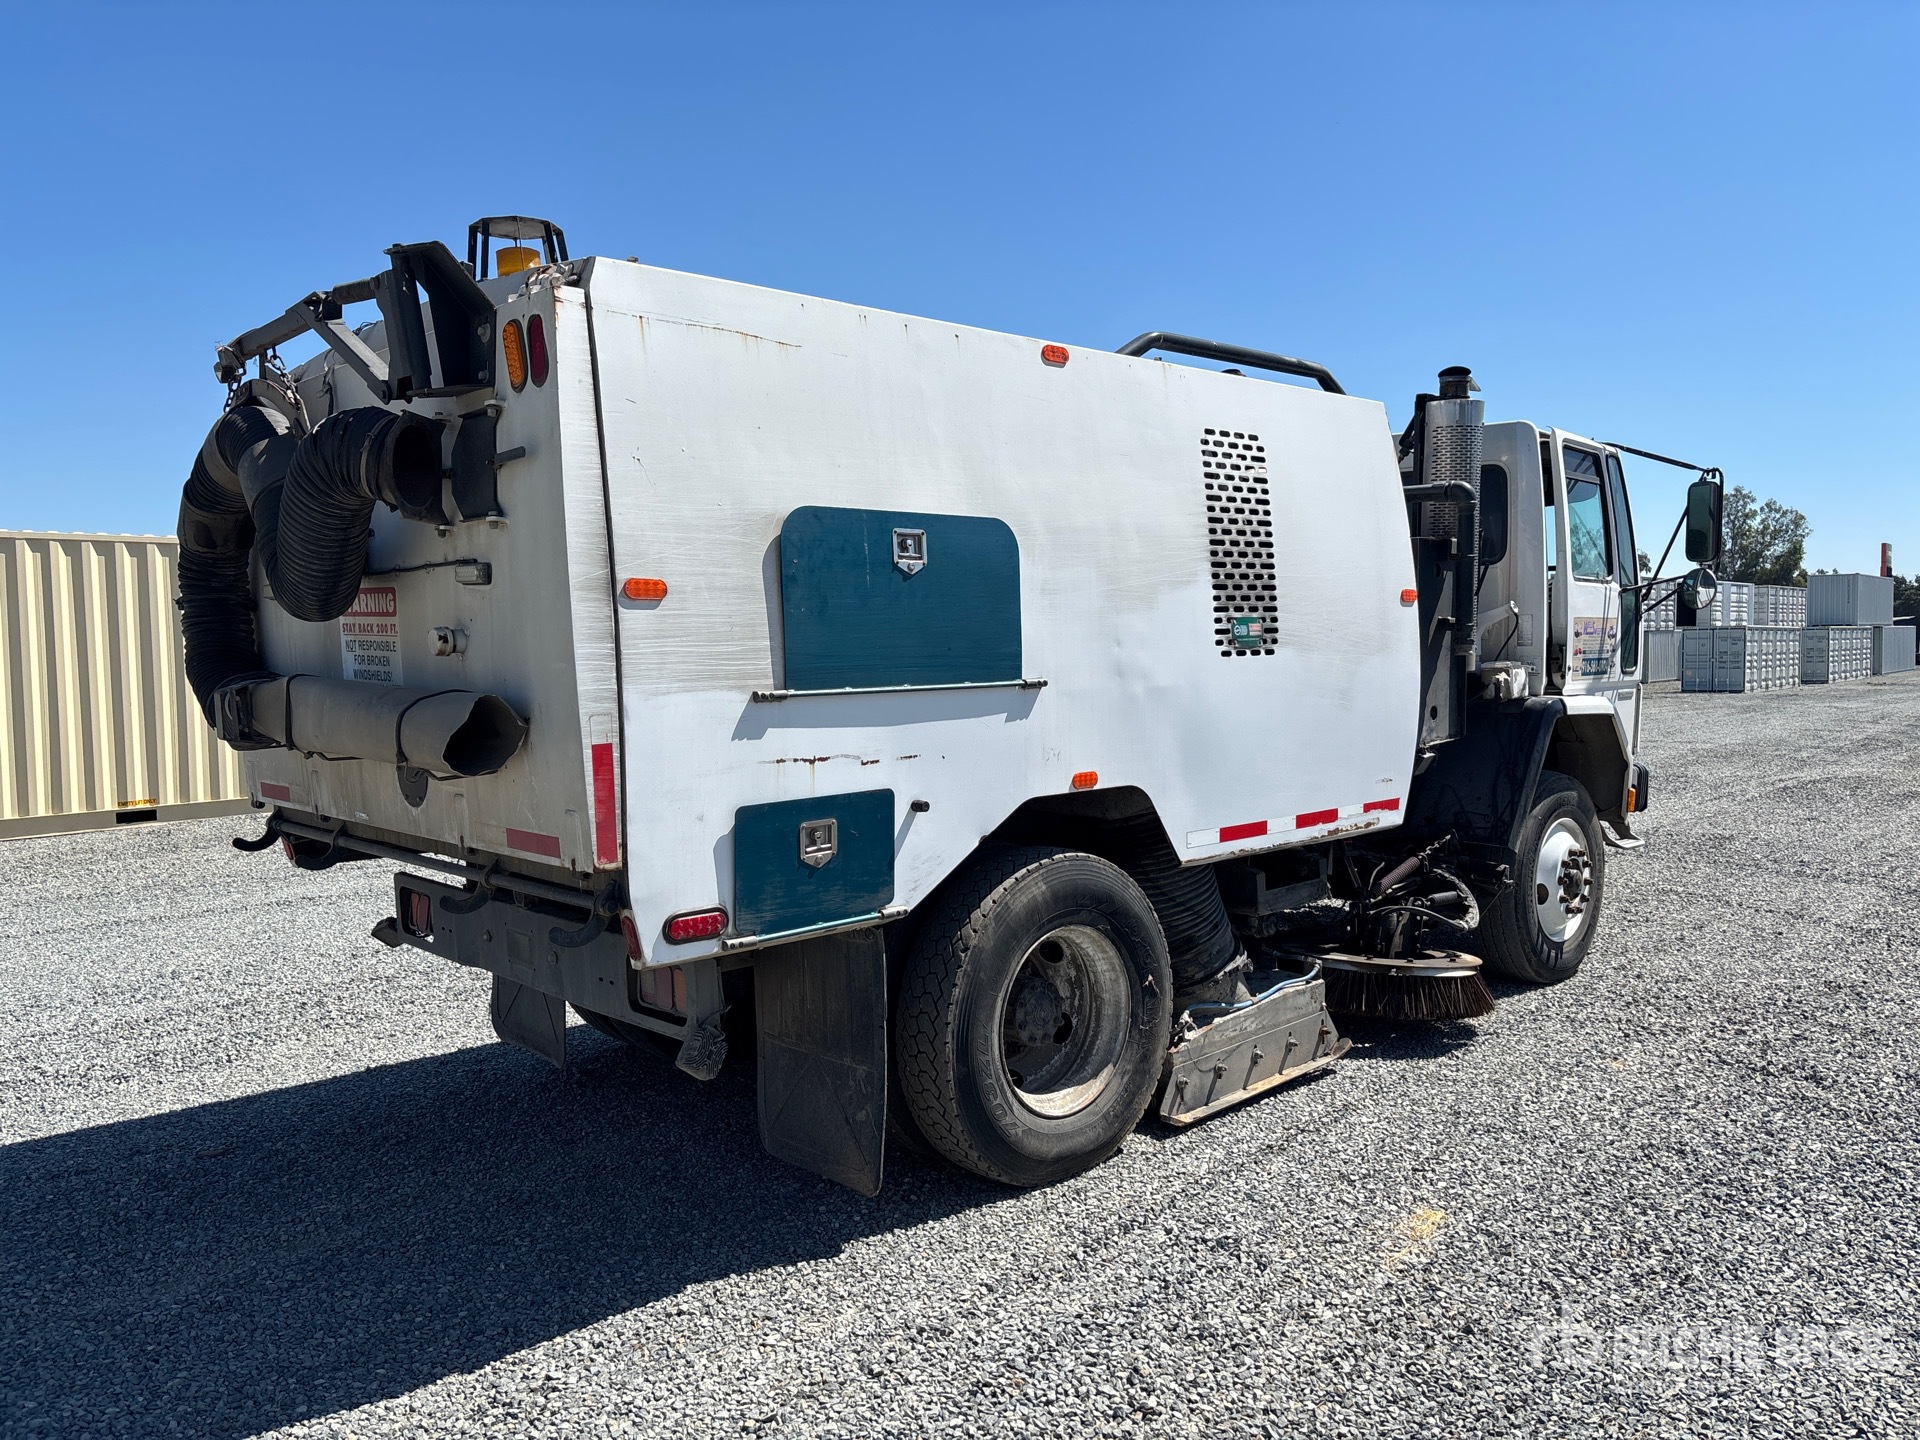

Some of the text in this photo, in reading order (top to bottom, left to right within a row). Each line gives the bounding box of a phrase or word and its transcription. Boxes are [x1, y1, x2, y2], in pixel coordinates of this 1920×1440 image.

[342, 623, 356, 633] STAY
[358, 623, 374, 634] BACK
[376, 623, 388, 634] 200
[345, 640, 396, 652] NOT RESPONSIBLE
[354, 654, 390, 667] FOR BROKEN
[353, 669, 393, 682] WINDSHIELDS!
